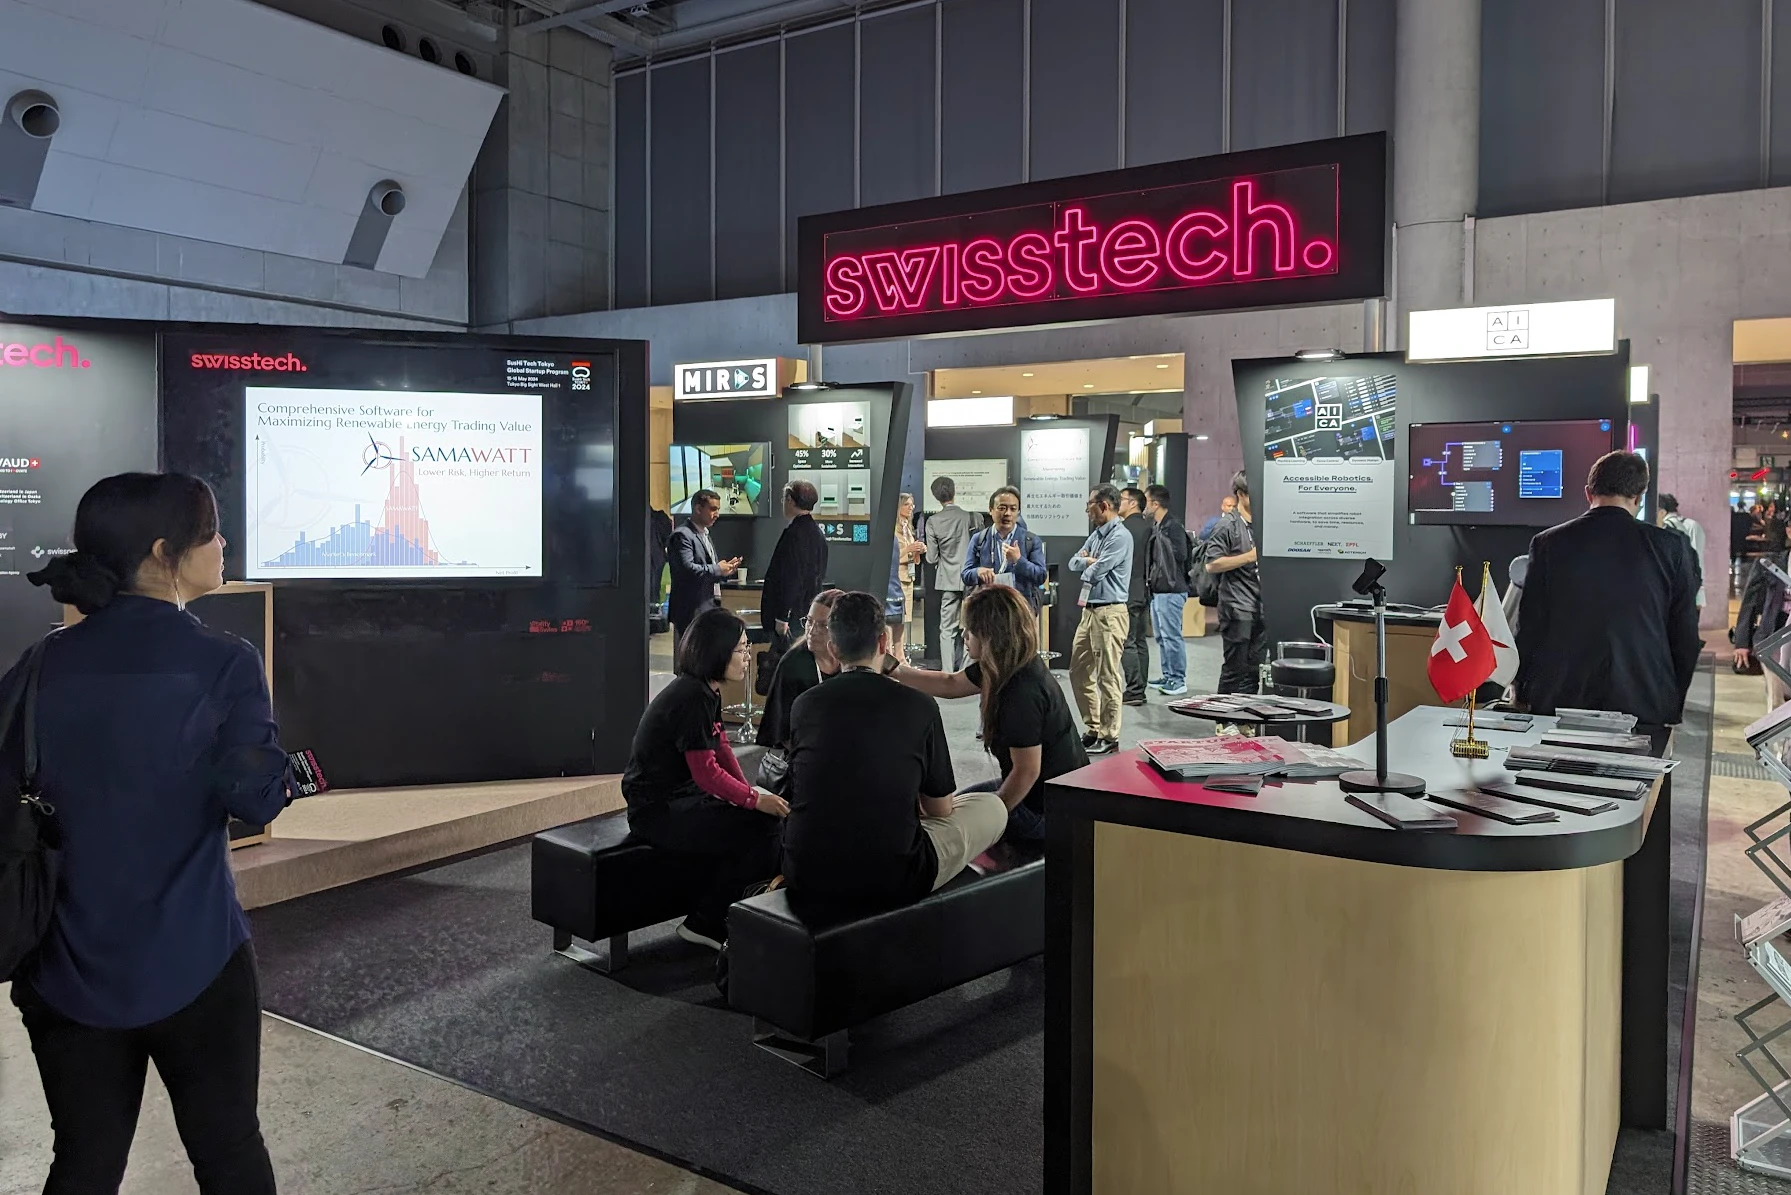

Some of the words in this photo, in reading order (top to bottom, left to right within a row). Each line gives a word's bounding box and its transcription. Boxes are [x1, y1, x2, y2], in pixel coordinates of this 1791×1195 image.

[826, 181, 1332, 315] swisstech.
[0, 336, 91, 368] ech.
[191, 352, 308, 372] swisstech.
[258, 402, 355, 416] Comprehensive
[359, 404, 413, 416] Software
[417, 406, 434, 417] for
[257, 416, 332, 430] Maximizing
[336, 417, 402, 429] Renewable
[451, 420, 496, 433] Trading
[500, 421, 532, 432] Value
[412, 446, 532, 463] SAMAWATT
[821, 449, 836, 458] 30%
[448, 468, 467, 477] Risk,
[469, 469, 498, 478] Higher
